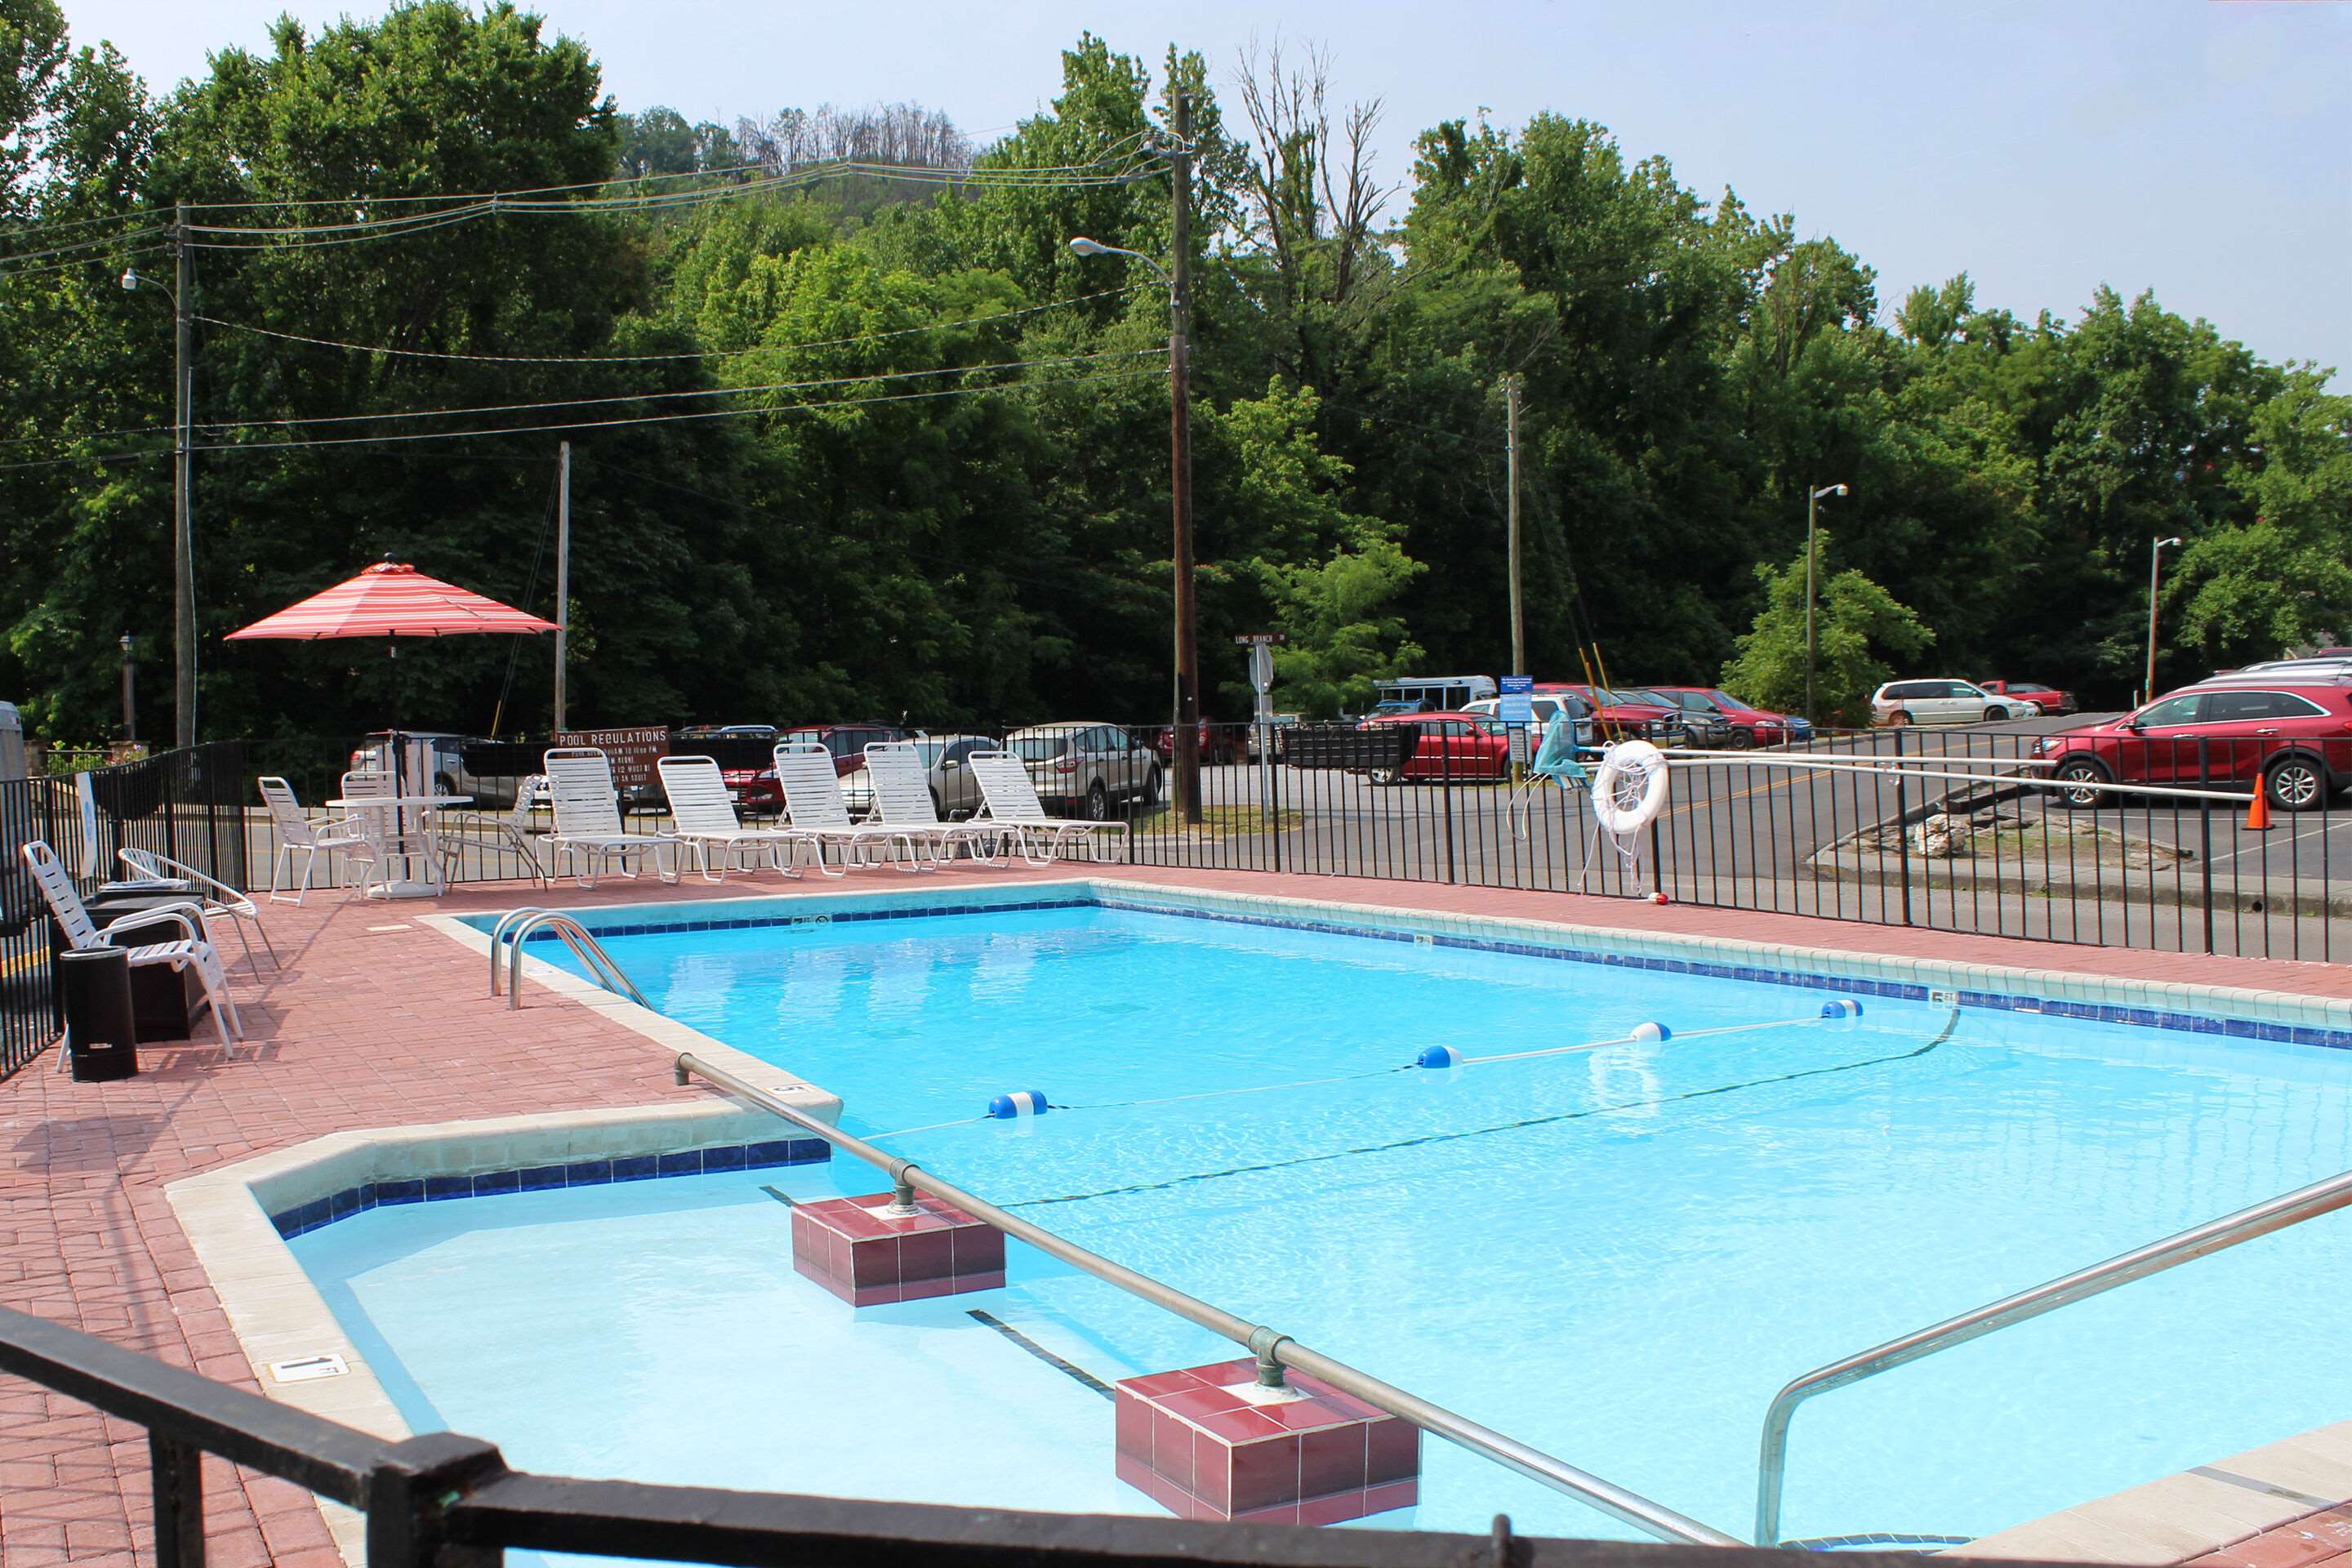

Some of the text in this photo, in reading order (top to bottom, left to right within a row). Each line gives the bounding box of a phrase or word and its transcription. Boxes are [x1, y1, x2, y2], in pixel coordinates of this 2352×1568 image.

[559, 730, 666, 746] POOL REGULATIONS
[1932, 991, 1944, 1003] 5
